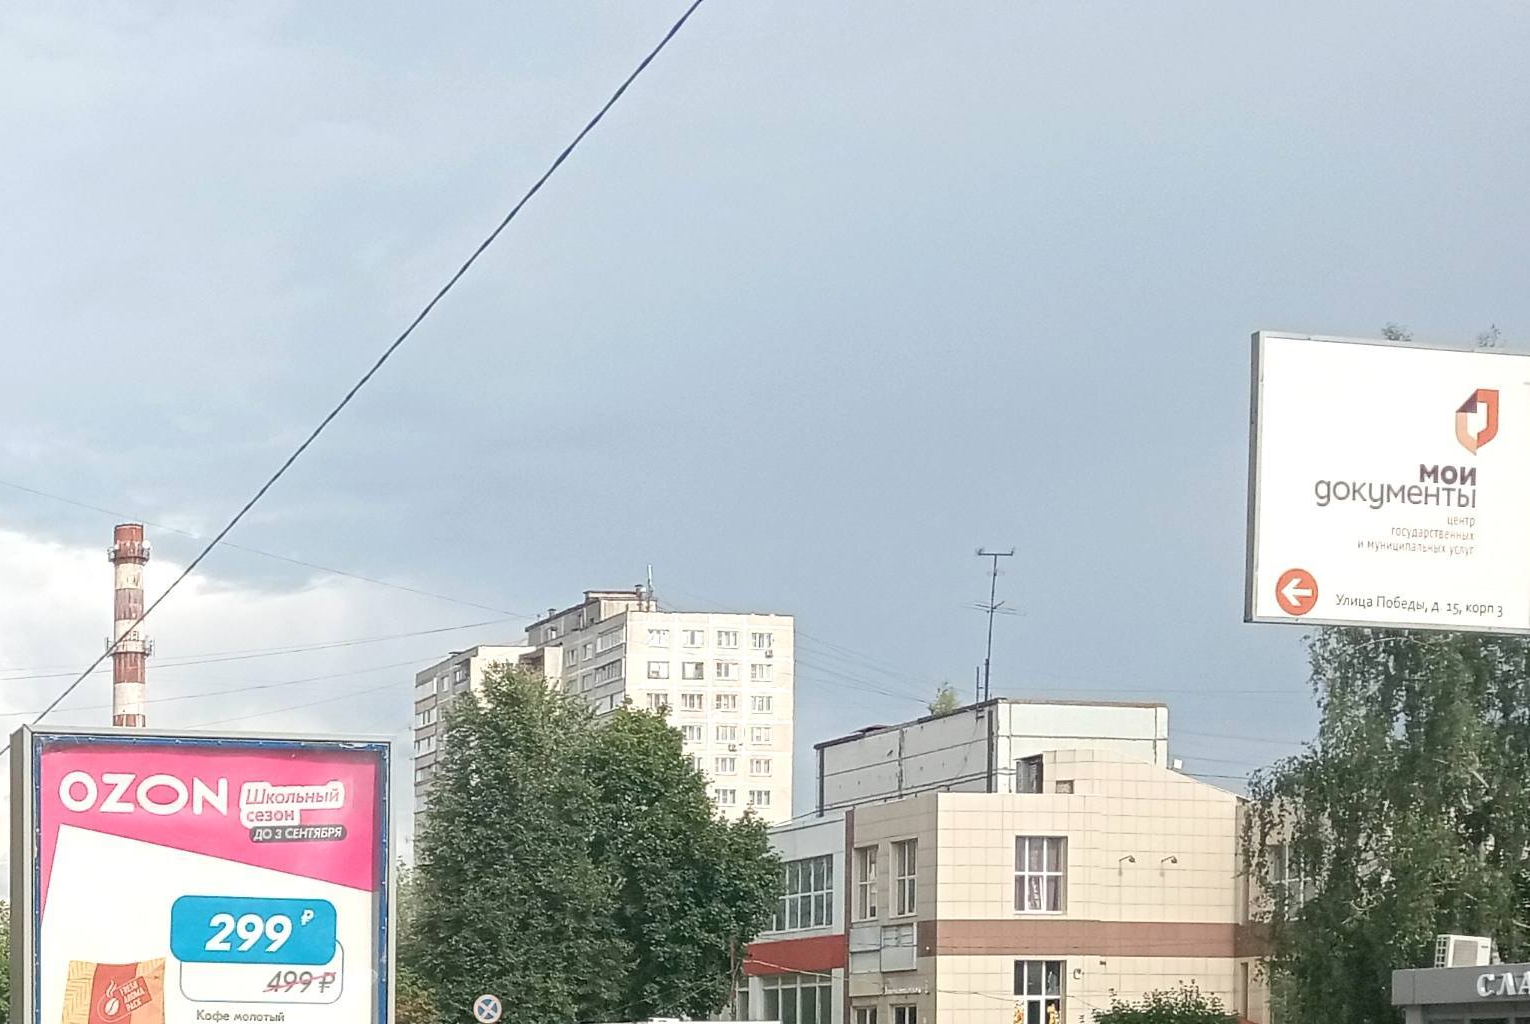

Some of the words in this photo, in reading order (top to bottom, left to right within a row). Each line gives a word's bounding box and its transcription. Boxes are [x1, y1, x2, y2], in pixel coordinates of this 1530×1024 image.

[1420, 463, 1477, 486] мои
[1314, 479, 1476, 510] документы
[1446, 515, 1475, 527] центр
[1391, 527, 1475, 541] государственных
[1357, 540, 1364, 549] и
[1367, 540, 1446, 554] муниципальных
[1449, 545, 1474, 557] услуг
[1335, 593, 1373, 609] Улица
[1376, 594, 1428, 613] Победы,
[1446, 602, 1463, 616] 15,
[1466, 602, 1494, 616] корп
[1497, 605, 1504, 618] 3
[58, 770, 228, 816] OZON
[244, 784, 341, 805] Школьный
[245, 808, 296, 822] сезон
[253, 829, 272, 842] ДО
[274, 829, 283, 840] 3
[285, 827, 343, 840] СЕНТЯБРЯ
[204, 912, 293, 953] 299
[265, 969, 313, 994] 499
[196, 1009, 230, 1022] Кофе
[233, 1011, 285, 1022] молотый
